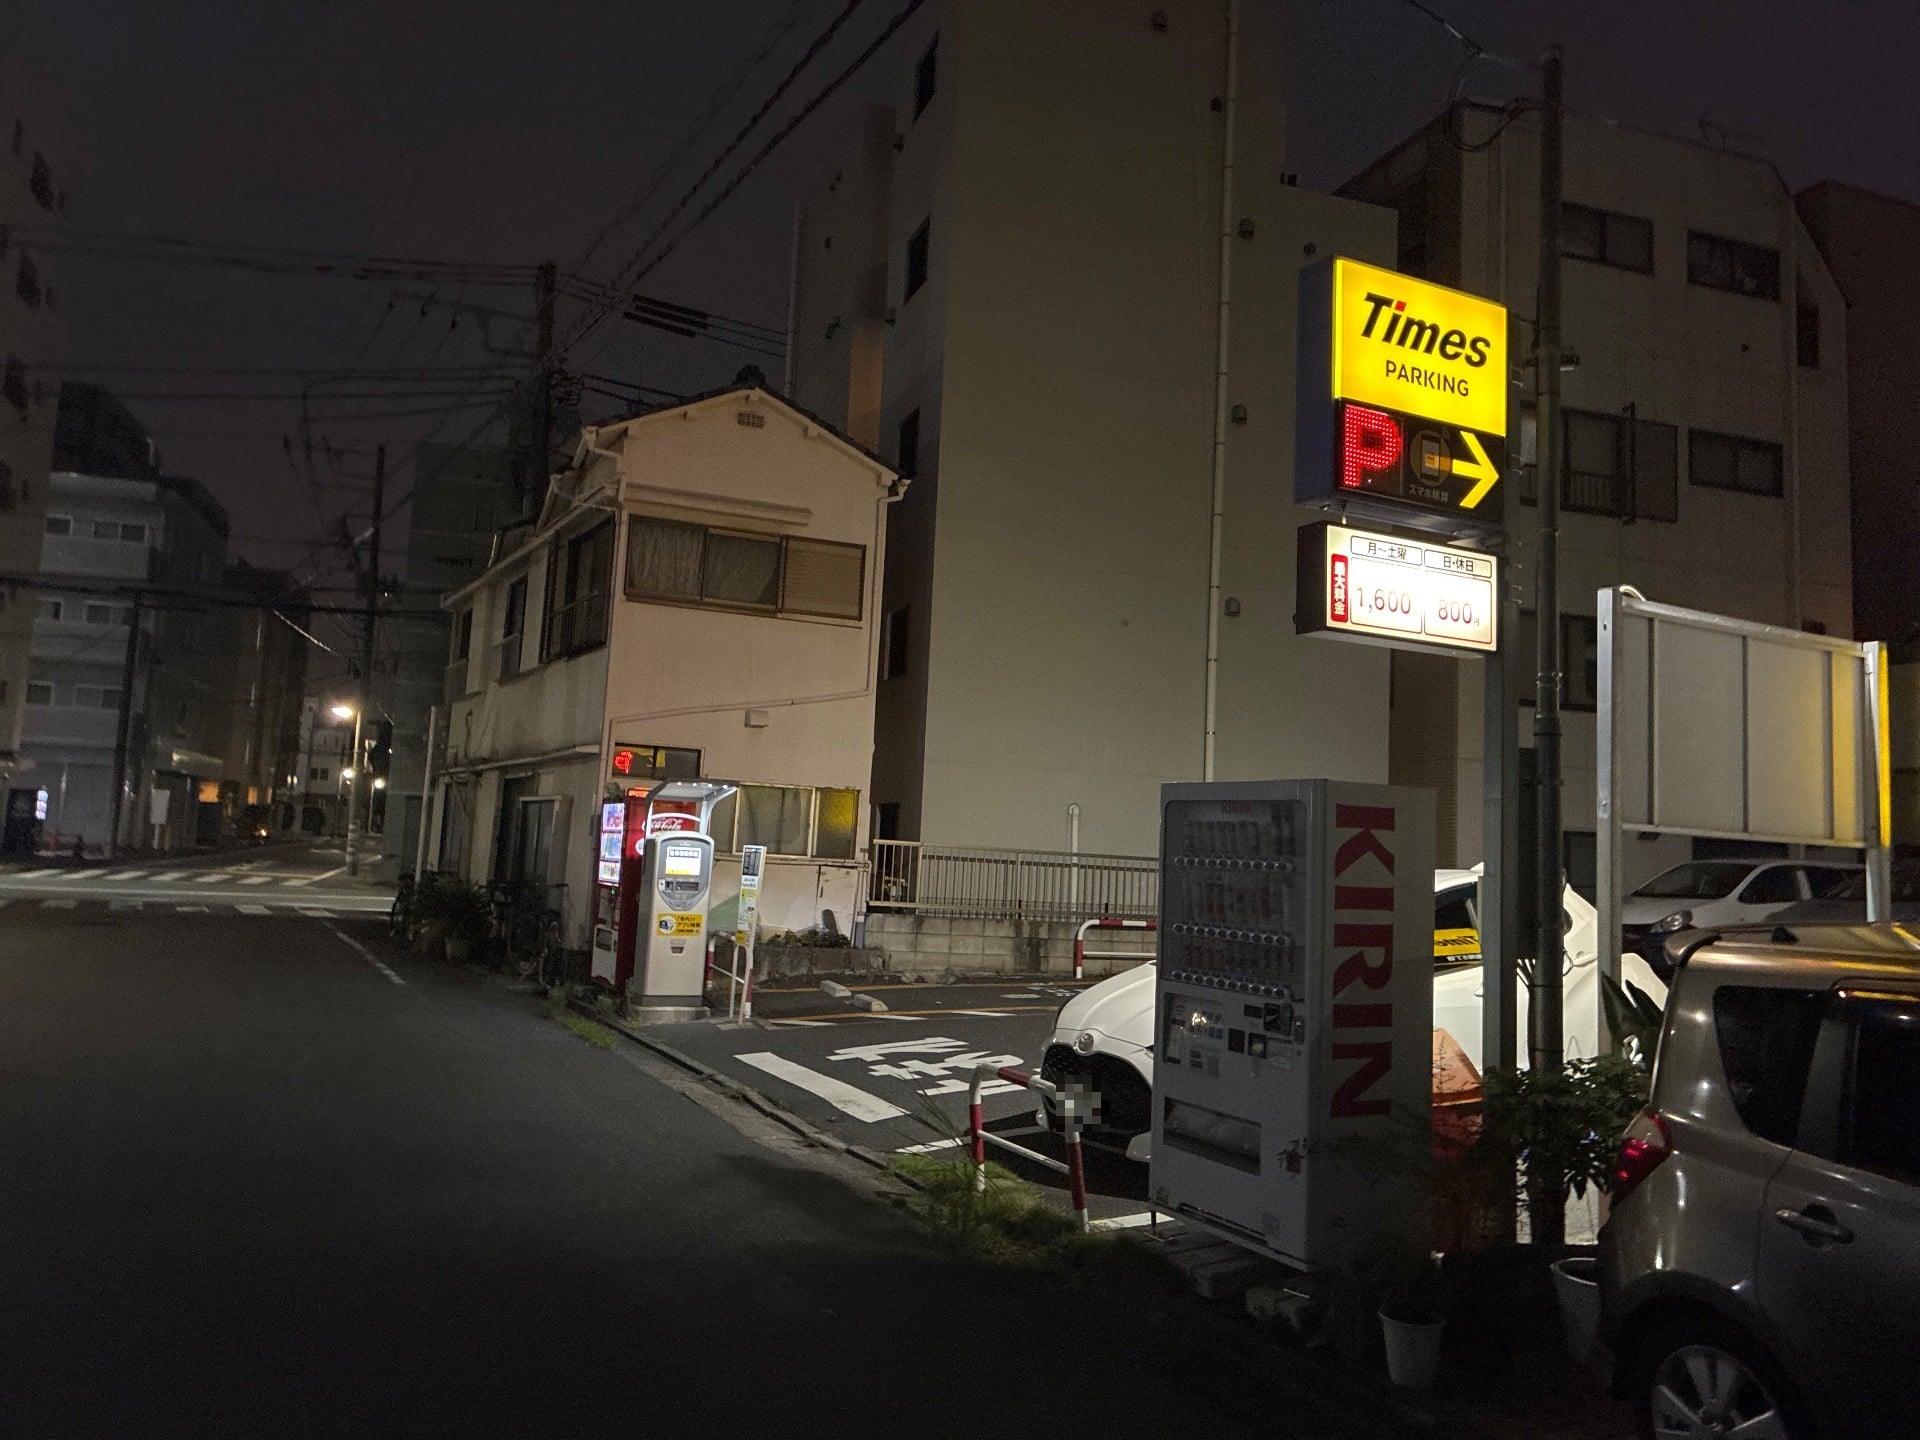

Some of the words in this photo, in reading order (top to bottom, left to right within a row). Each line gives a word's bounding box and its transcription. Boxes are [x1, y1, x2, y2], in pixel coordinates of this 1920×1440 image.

[1361, 292, 1491, 368] Times
[1385, 360, 1469, 397] PARKING
[1344, 404, 1403, 487] P
[1444, 556, 1474, 572] 日・休日
[1356, 586, 1411, 614] 1,600
[1330, 802, 1396, 1118] KIRIN
